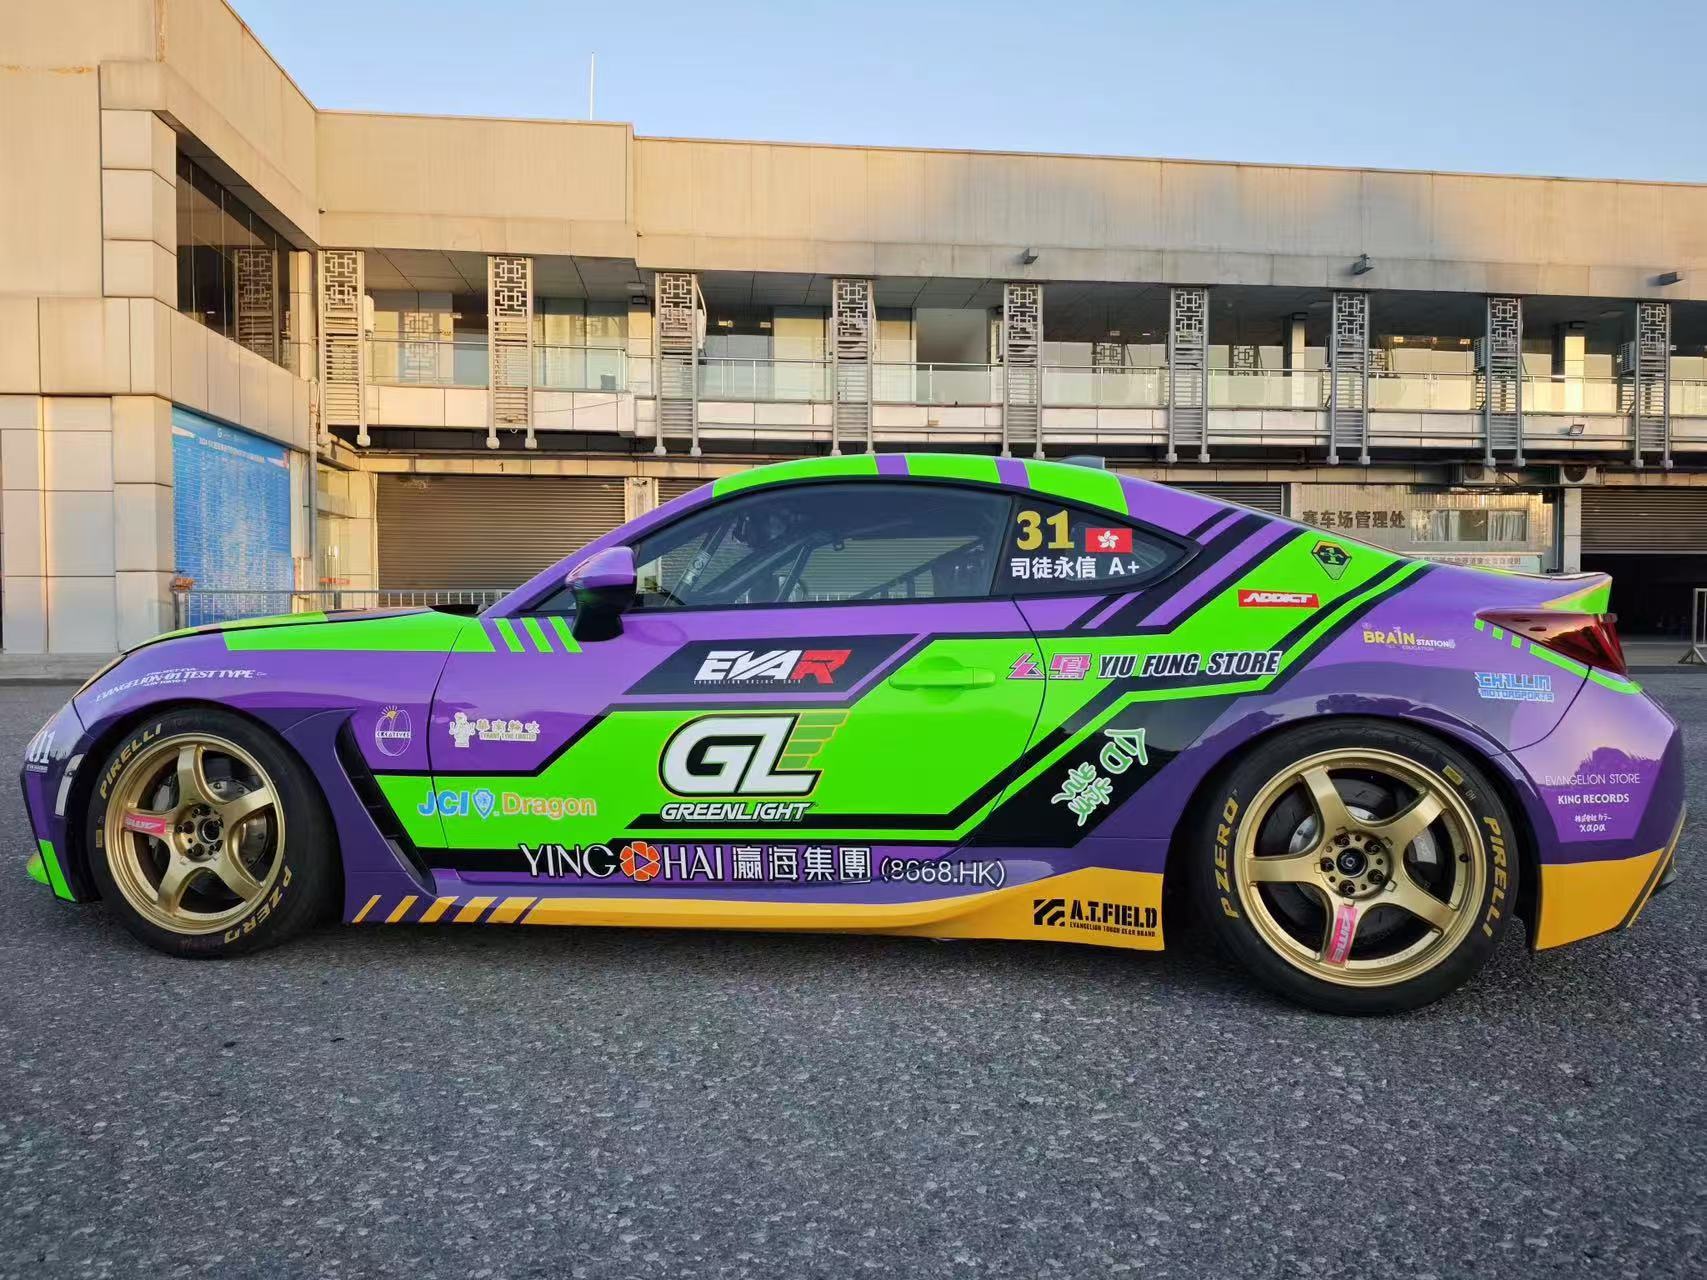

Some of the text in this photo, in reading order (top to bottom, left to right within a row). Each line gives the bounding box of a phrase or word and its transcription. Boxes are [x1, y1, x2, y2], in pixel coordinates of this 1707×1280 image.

[1016, 509, 1075, 551] 31
[1302, 510, 1405, 529] 赛车场管理处
[1011, 556, 1140, 579] 司徒永信 A+
[1243, 592, 1313, 604] ADDICT
[1363, 626, 1450, 648] BRAIN STATION
[185, 670, 216, 679] TEST
[218, 669, 256, 679] TYPE
[1098, 653, 1137, 679] YIU
[1141, 652, 1201, 678] FUNG
[1206, 650, 1284, 677] STORE
[1478, 687, 1555, 703] MOTORSPORTS
[99, 722, 162, 800] PIRELLI
[658, 711, 825, 799] GL
[1545, 773, 1641, 786] EVANGELION STORE
[418, 790, 597, 820] JCI Dragon
[1558, 793, 1630, 805] KING RECORDS
[660, 802, 814, 822] GREENLIGHT
[519, 844, 1006, 889] YING HAI 瀛海集團 (8668.HK)
[1482, 816, 1508, 938] PIRELLI
[1070, 899, 1158, 929] A.T.FIELD
[1069, 921, 1102, 931] EVANGELION
[1136, 929, 1156, 938] BRAND
